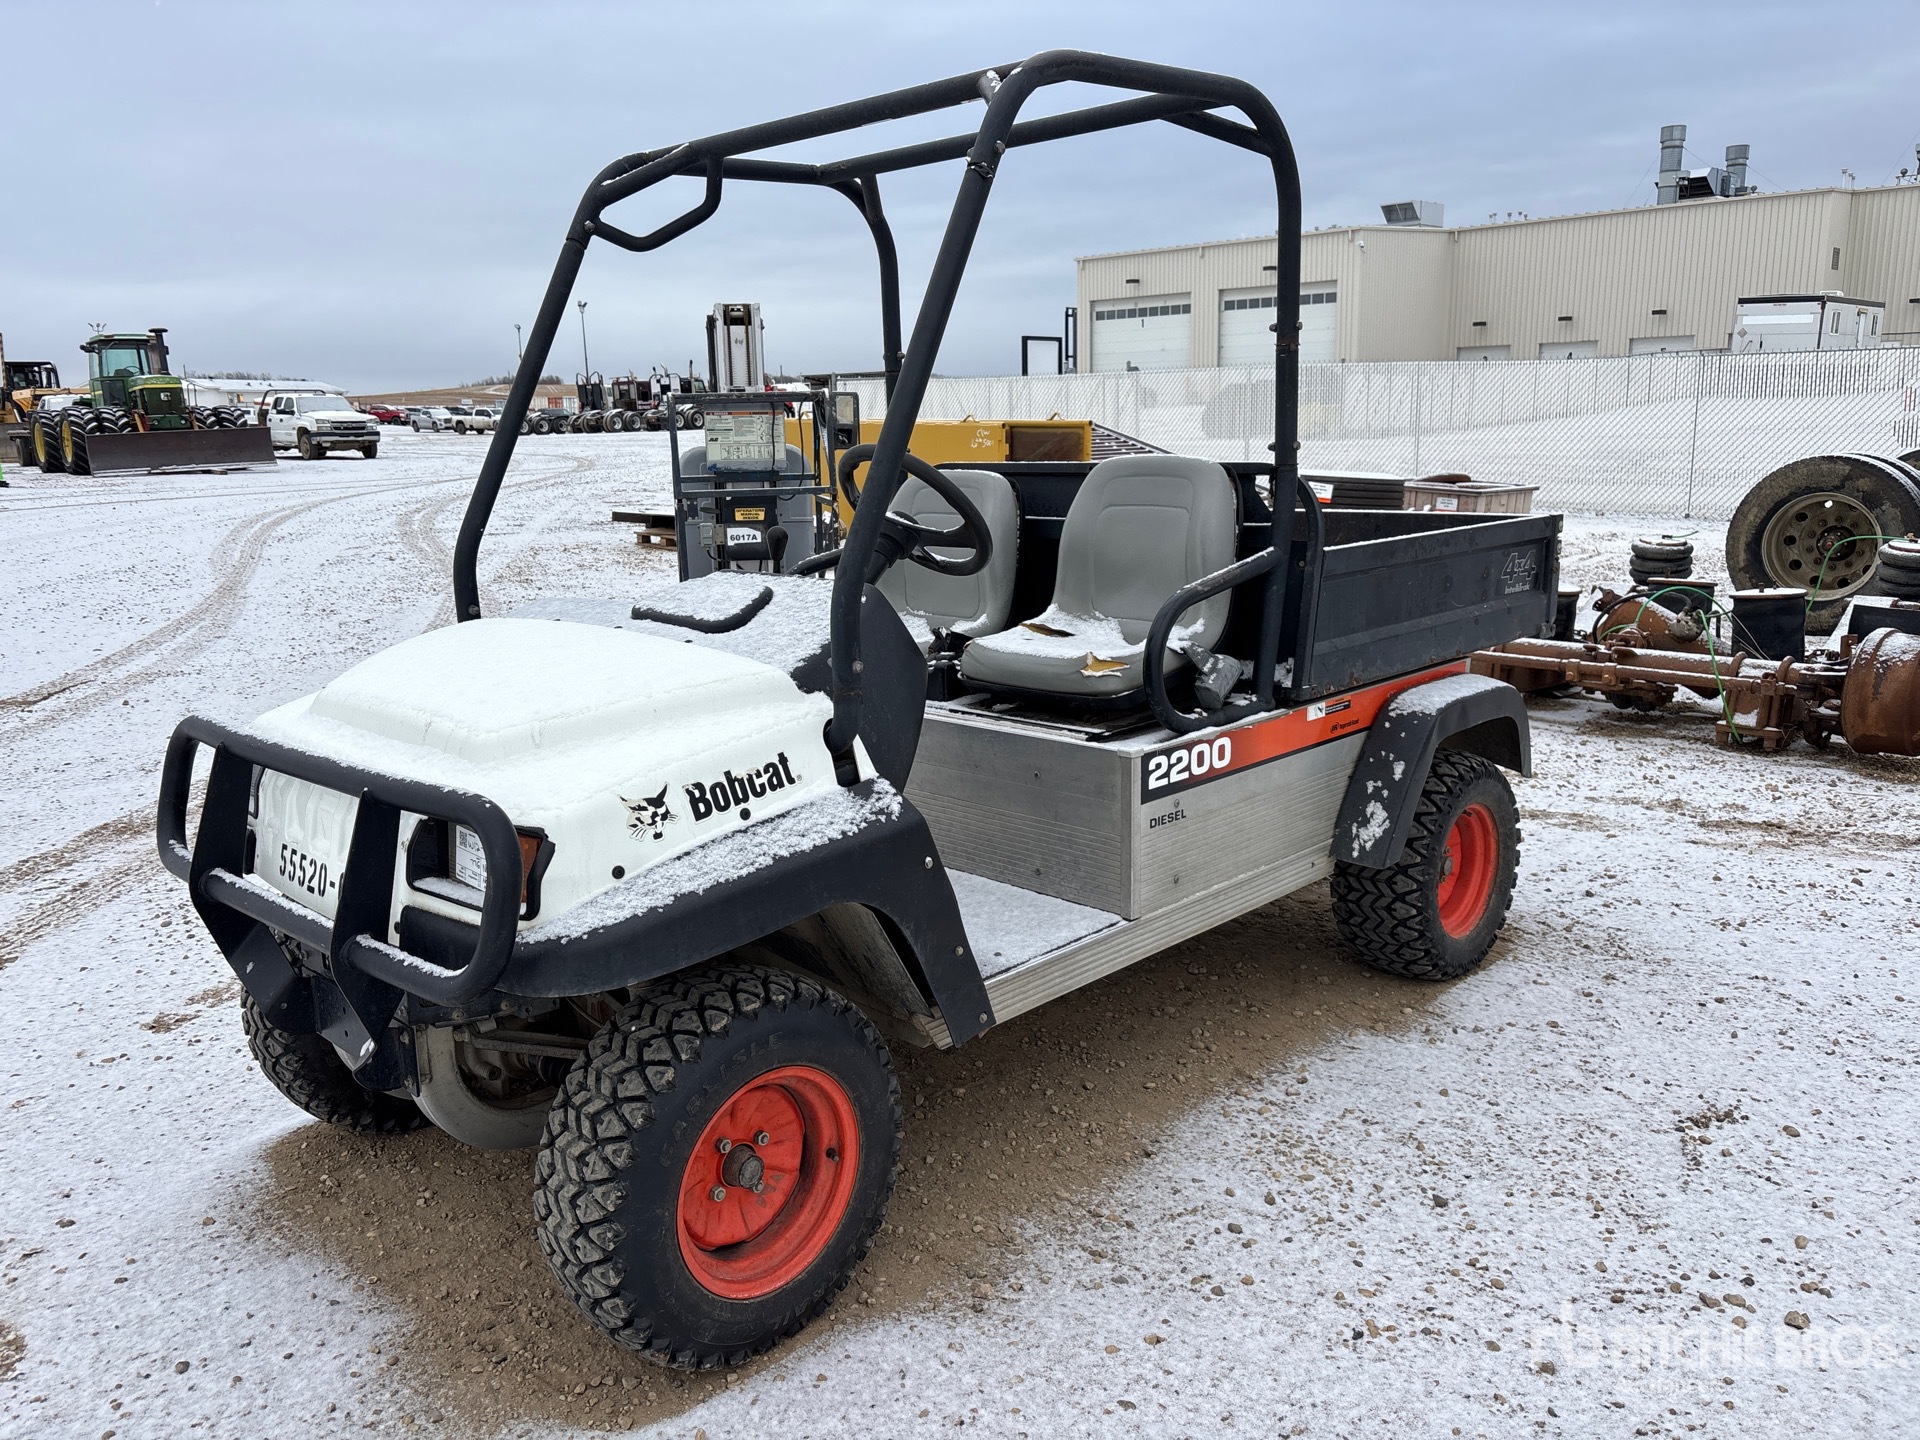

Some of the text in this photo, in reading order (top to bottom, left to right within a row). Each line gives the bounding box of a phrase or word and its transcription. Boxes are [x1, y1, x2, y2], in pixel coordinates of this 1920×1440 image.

[730, 534, 758, 542] 6017A
[682, 751, 796, 823] Bobcat
[1148, 736, 1232, 790] 2200
[1149, 809, 1187, 829] DIESEL
[658, 1030, 785, 1168] CARLISLE
